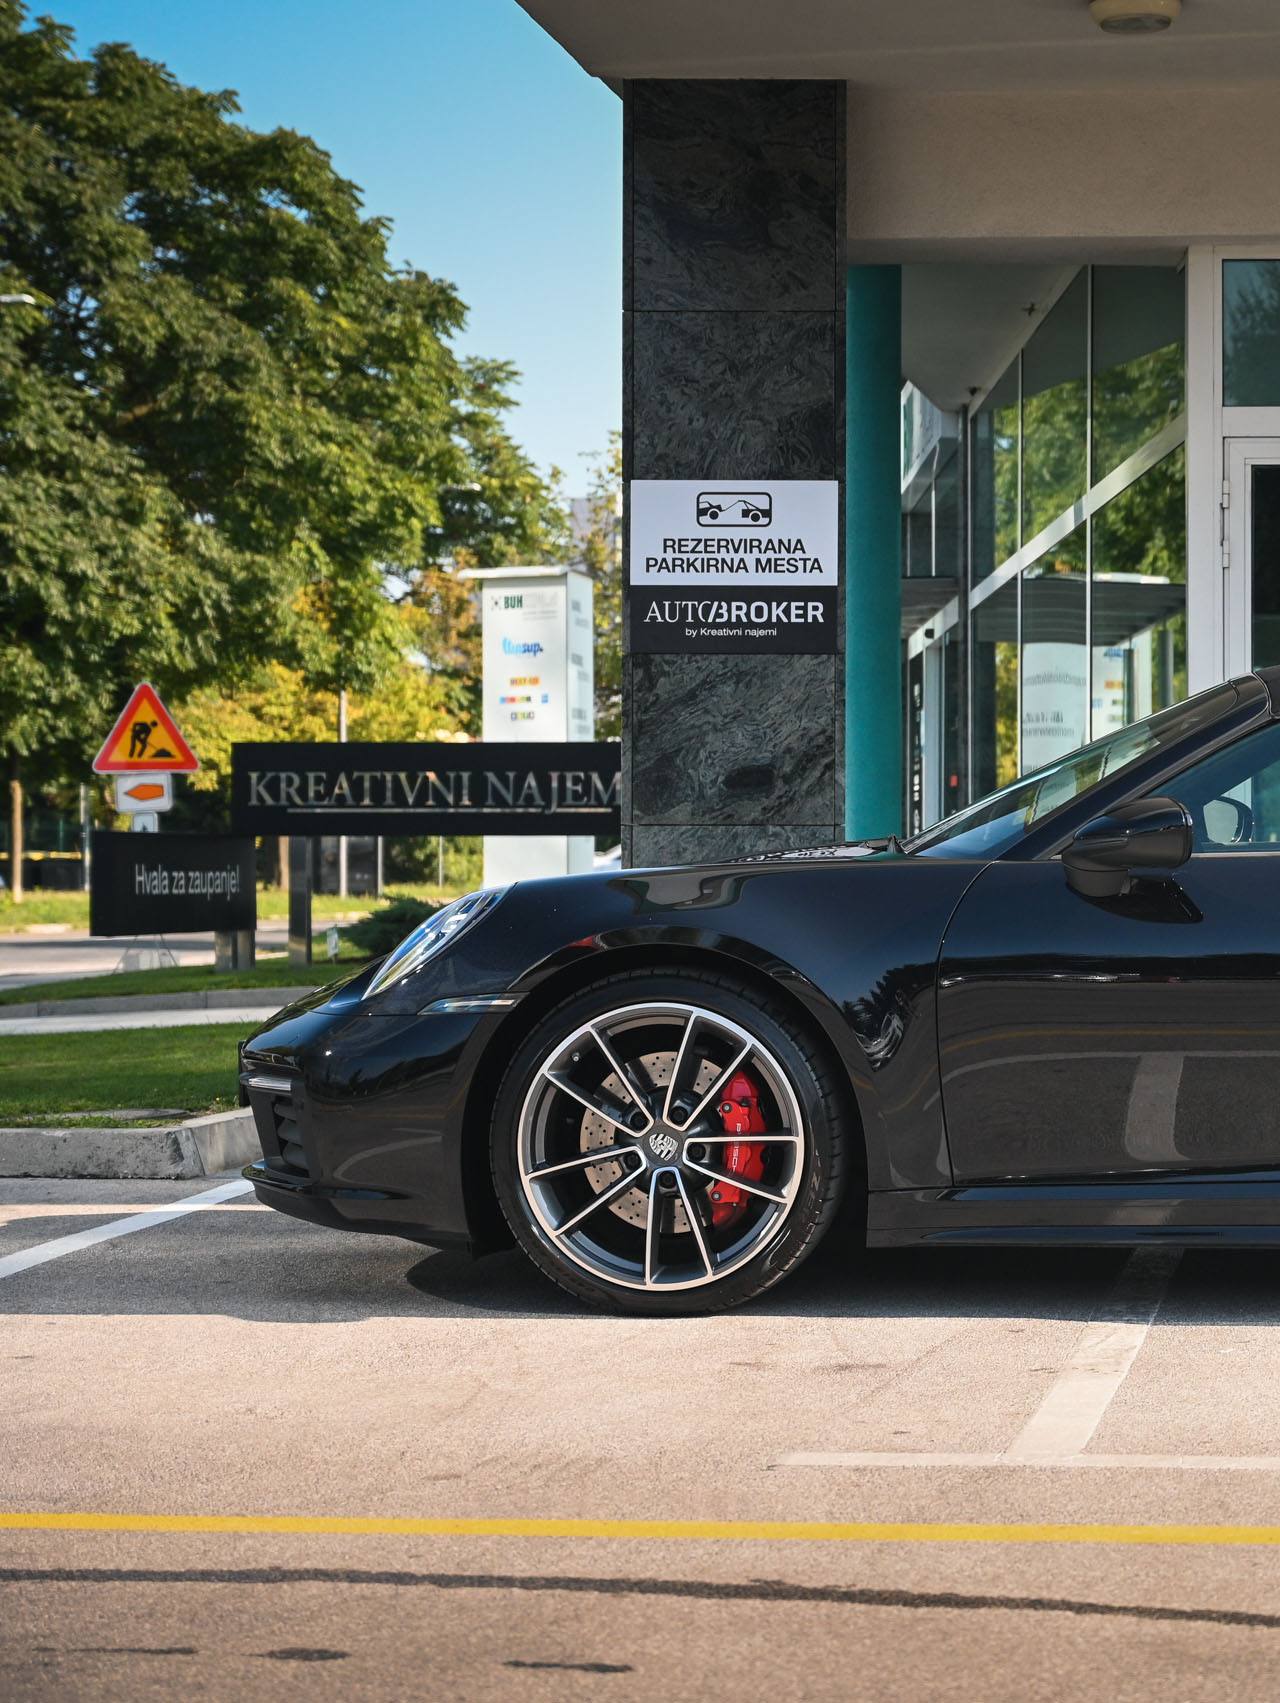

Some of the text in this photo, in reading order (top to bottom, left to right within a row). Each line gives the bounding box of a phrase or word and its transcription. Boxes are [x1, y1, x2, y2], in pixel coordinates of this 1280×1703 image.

[663, 538, 806, 554] REZERVIRANA
[645, 557, 823, 573] PARKIRNA MESTA
[685, 627, 777, 638] by Kreativni najemi
[247, 771, 472, 806] KREATIVNI
[135, 863, 240, 901] Hvala za zaupanje!
